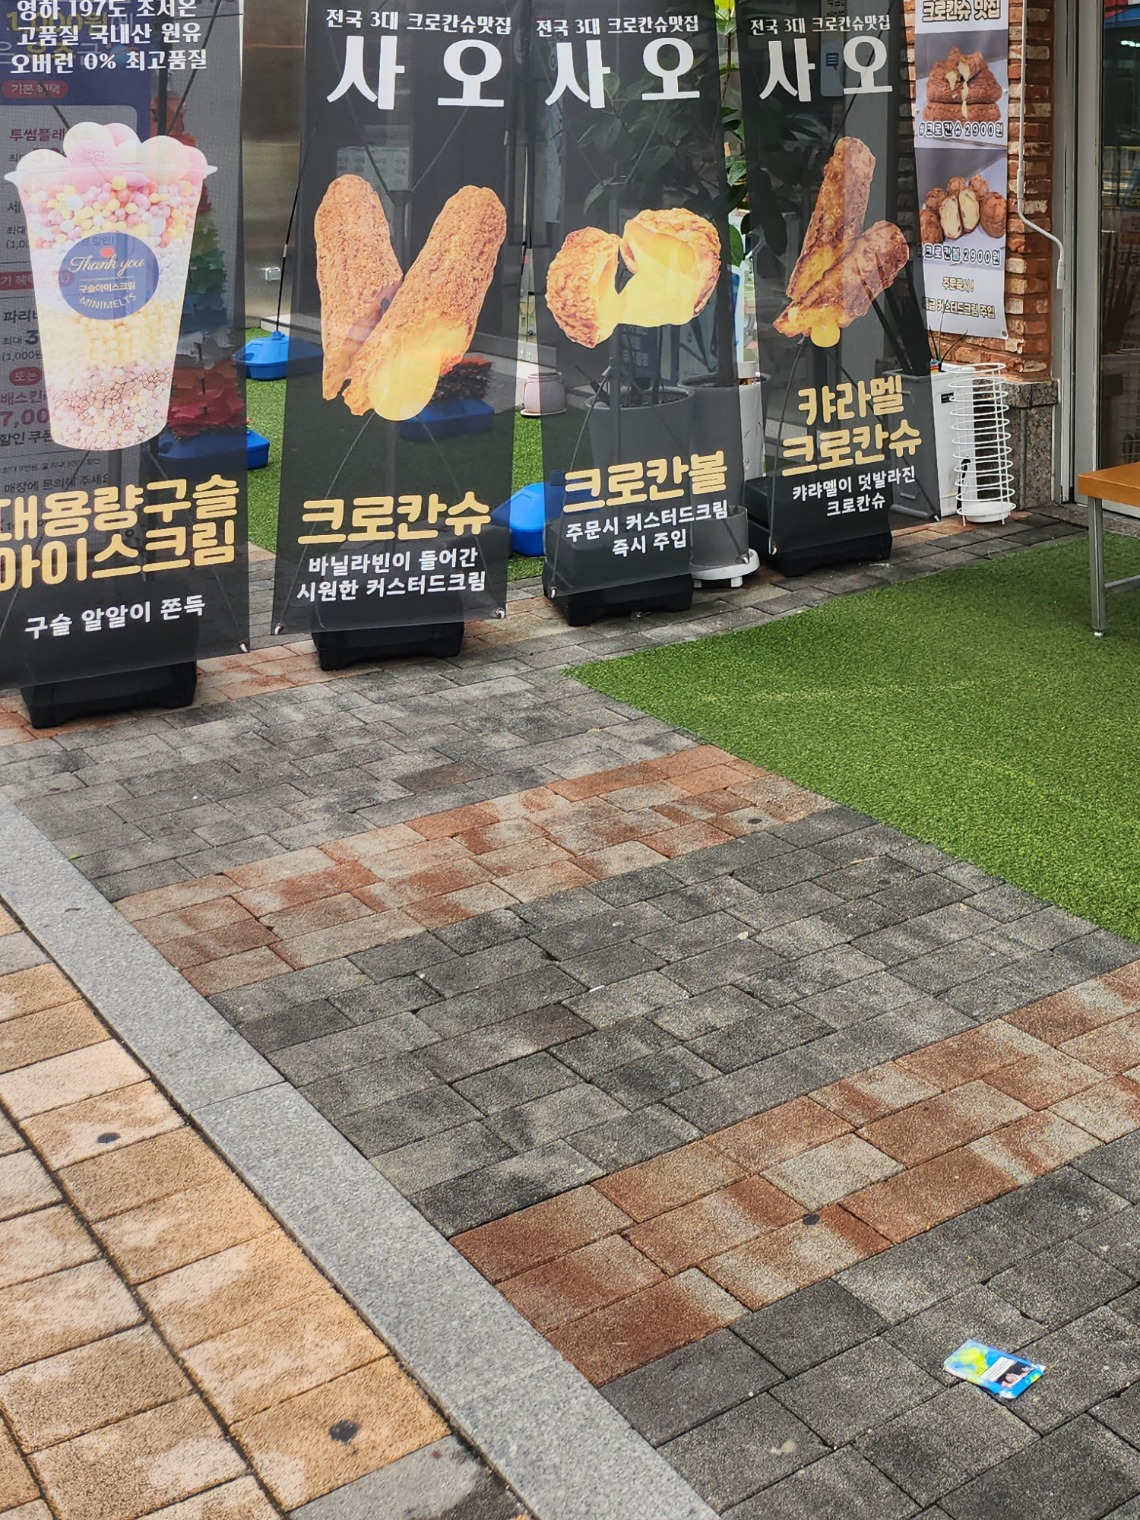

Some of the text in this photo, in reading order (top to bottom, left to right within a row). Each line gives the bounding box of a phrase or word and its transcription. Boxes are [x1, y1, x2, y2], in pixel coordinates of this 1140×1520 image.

[17, 0, 61, 21] 영하
[326, 9, 512, 35] 전국 3대 크로칸슈맛집
[921, 0, 971, 23] 크로칸슈
[16, 24, 79, 47] 고품질
[90, 23, 153, 45] 국내산
[161, 22, 202, 44] 원유
[536, 14, 700, 38] 전국 3대 크로칸슈맛집
[750, 14, 891, 37] 전국 3대 크로칸슈맛집
[10, 48, 208, 74] 오버런 0% 최고품질
[9, 128, 66, 143] 투썸플레
[964, 120, 1004, 138] 2900원
[68, 253, 145, 277] Thank you
[79, 292, 137, 310] MINIMELTS
[797, 374, 905, 426] 캬라멜
[0, 408, 50, 429] 7,00
[781, 419, 923, 478] 크로칸슈
[563, 449, 728, 514] 크로칸볼
[858, 465, 916, 493] 덧발라진
[0, 473, 240, 543] 대용량구슬
[297, 490, 492, 545] 크로칸슈
[826, 493, 887, 518] 크로칸슈
[565, 499, 729, 543] 주문시 커스터드크림
[0, 518, 235, 592] 아이스크림
[612, 527, 687, 558] 즉시 주입
[308, 546, 479, 577] 바닐라빈이 들어간
[296, 570, 486, 603] 시원한 커스터드크림
[24, 593, 206, 640] 구슬 알알이 쫀득
